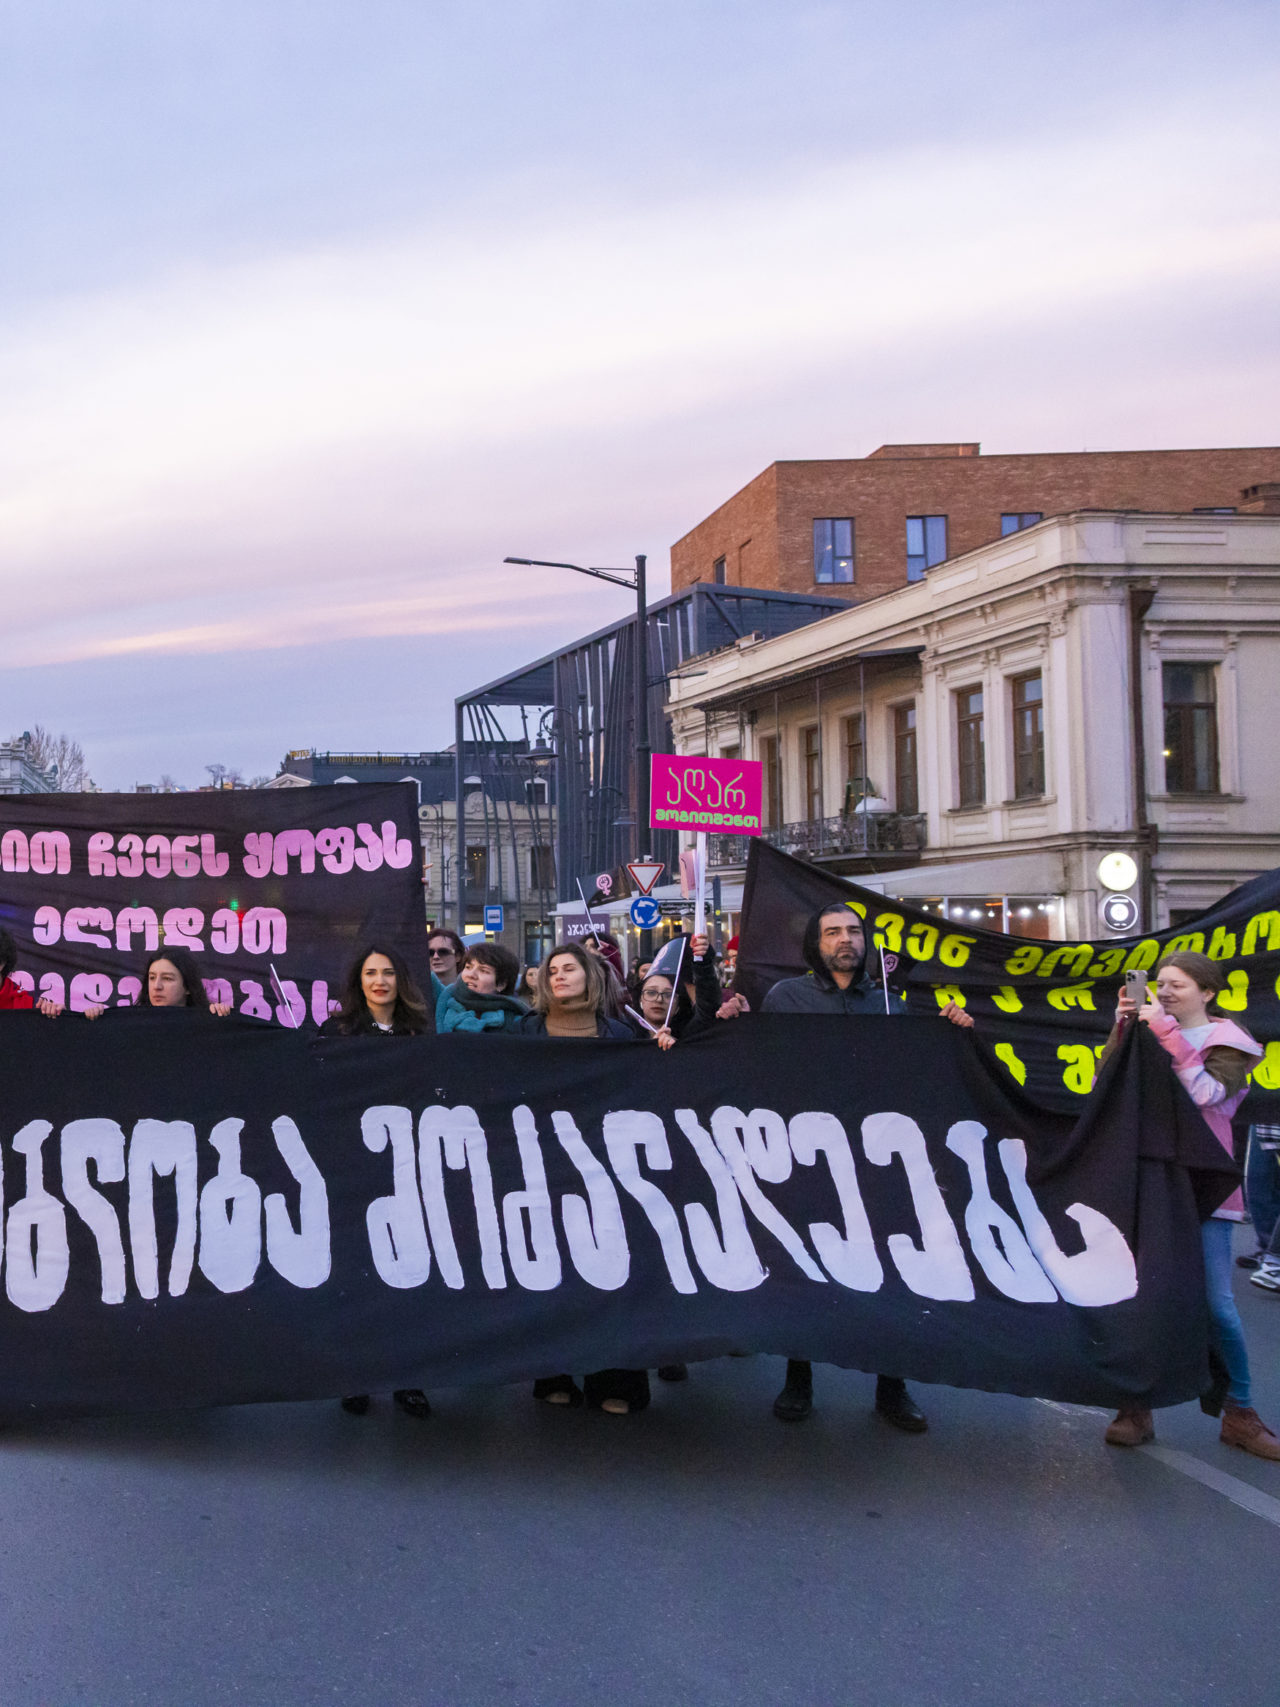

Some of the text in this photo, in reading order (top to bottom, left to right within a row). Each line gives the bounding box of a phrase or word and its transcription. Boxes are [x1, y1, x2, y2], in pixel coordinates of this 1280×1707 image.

[666, 767, 743, 809] აღარ
[655, 808, 759, 828] მოგითმენთ
[88, 832, 230, 878] ჩვენს
[243, 820, 412, 878] ყოფას
[33, 906, 287, 954] ელოდეთ
[360, 1103, 1140, 1309] მოძალადეებს
